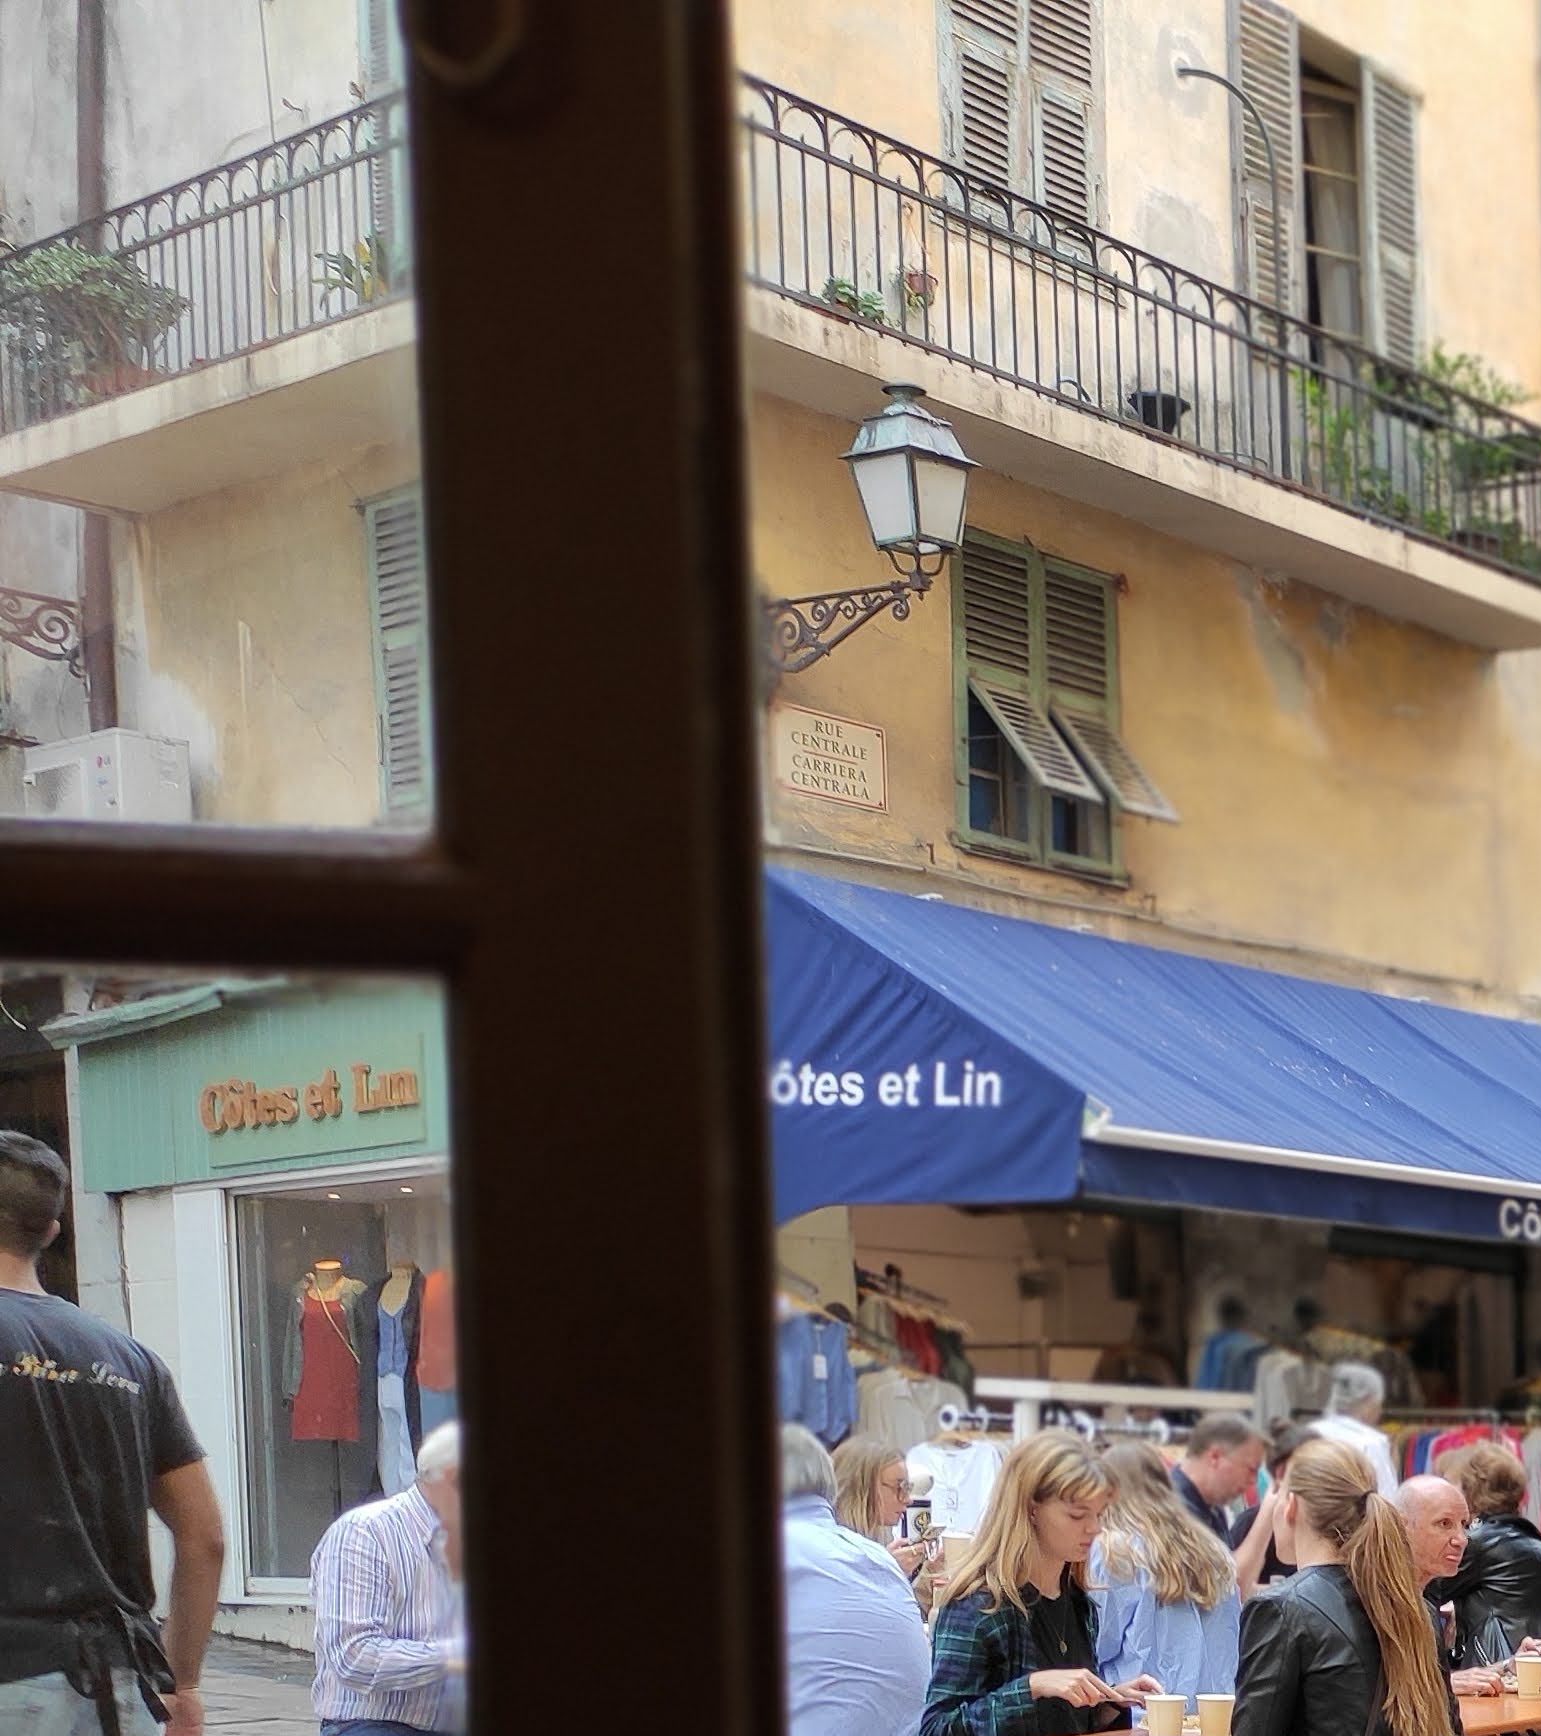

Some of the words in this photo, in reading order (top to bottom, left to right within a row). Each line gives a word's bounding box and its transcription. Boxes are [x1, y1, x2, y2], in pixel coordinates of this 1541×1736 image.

[814, 719, 843, 739] RUE
[791, 731, 868, 761] CENTRALE
[792, 753, 867, 783] CARRIERA
[791, 771, 870, 800] CENTRALA
[770, 1058, 864, 1106] ôtes
[878, 1064, 920, 1107] et
[934, 1060, 1001, 1107] Lin
[200, 1079, 299, 1135] Côtes
[304, 1068, 343, 1121] et
[351, 1063, 420, 1117] Lin
